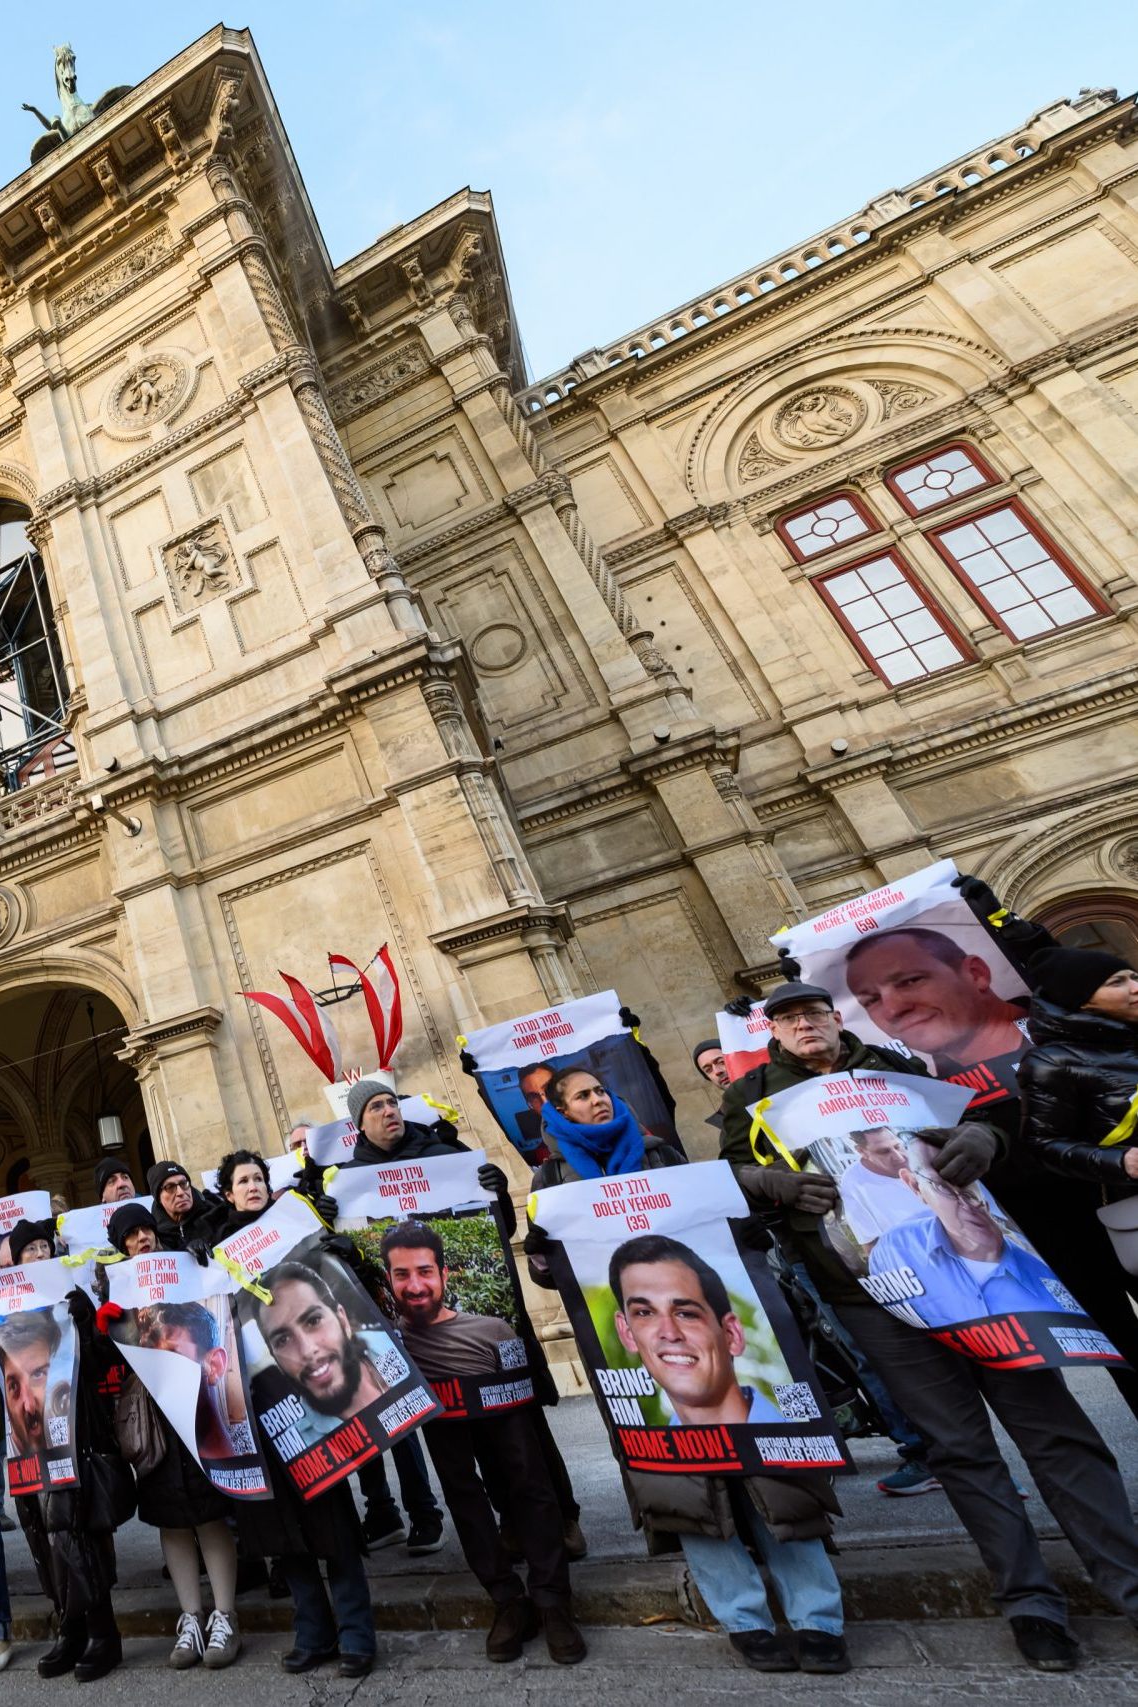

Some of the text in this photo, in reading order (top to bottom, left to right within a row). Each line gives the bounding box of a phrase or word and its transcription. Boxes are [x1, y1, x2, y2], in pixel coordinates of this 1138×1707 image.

[813, 891, 905, 934] MICHEL NISENBAUM
[854, 916, 879, 934] (59)
[512, 1022, 575, 1049] TAMIR NIMRODI
[540, 1041, 558, 1056] (19)
[818, 1093, 910, 1116] AMIRAM COOPER
[862, 1108, 889, 1125] (85)
[404, 1166, 424, 1181] עידן
[379, 1179, 431, 1197] IDAN SHTIVI
[600, 1178, 651, 1199] דולב יהוד
[399, 1195, 418, 1211] (28)
[592, 1193, 672, 1218] DOLEV YEHOUD
[626, 1213, 651, 1232] (35)
[241, 1230, 280, 1262] ZANGAUKER
[153, 1258, 176, 1271] אריאל
[245, 1257, 264, 1276] (24)
[156, 1273, 179, 1285] CUNIO
[857, 1266, 925, 1304] BRING
[150, 1286, 165, 1301] (26)
[956, 1315, 1037, 1358] NOW!
[595, 1366, 655, 1396] BRING
[481, 1386, 534, 1408] FAMILIES FORUM
[259, 1394, 305, 1438] BRING
[383, 1397, 434, 1435] FAMILIES FORUM
[606, 1398, 646, 1426] HIM
[273, 1424, 307, 1463] HIM
[288, 1416, 373, 1489] HOME NOW!
[618, 1424, 737, 1459] HOME NOW!
[760, 1446, 842, 1461] FAMILIES FORUM
[242, 1475, 266, 1490] FORUM
